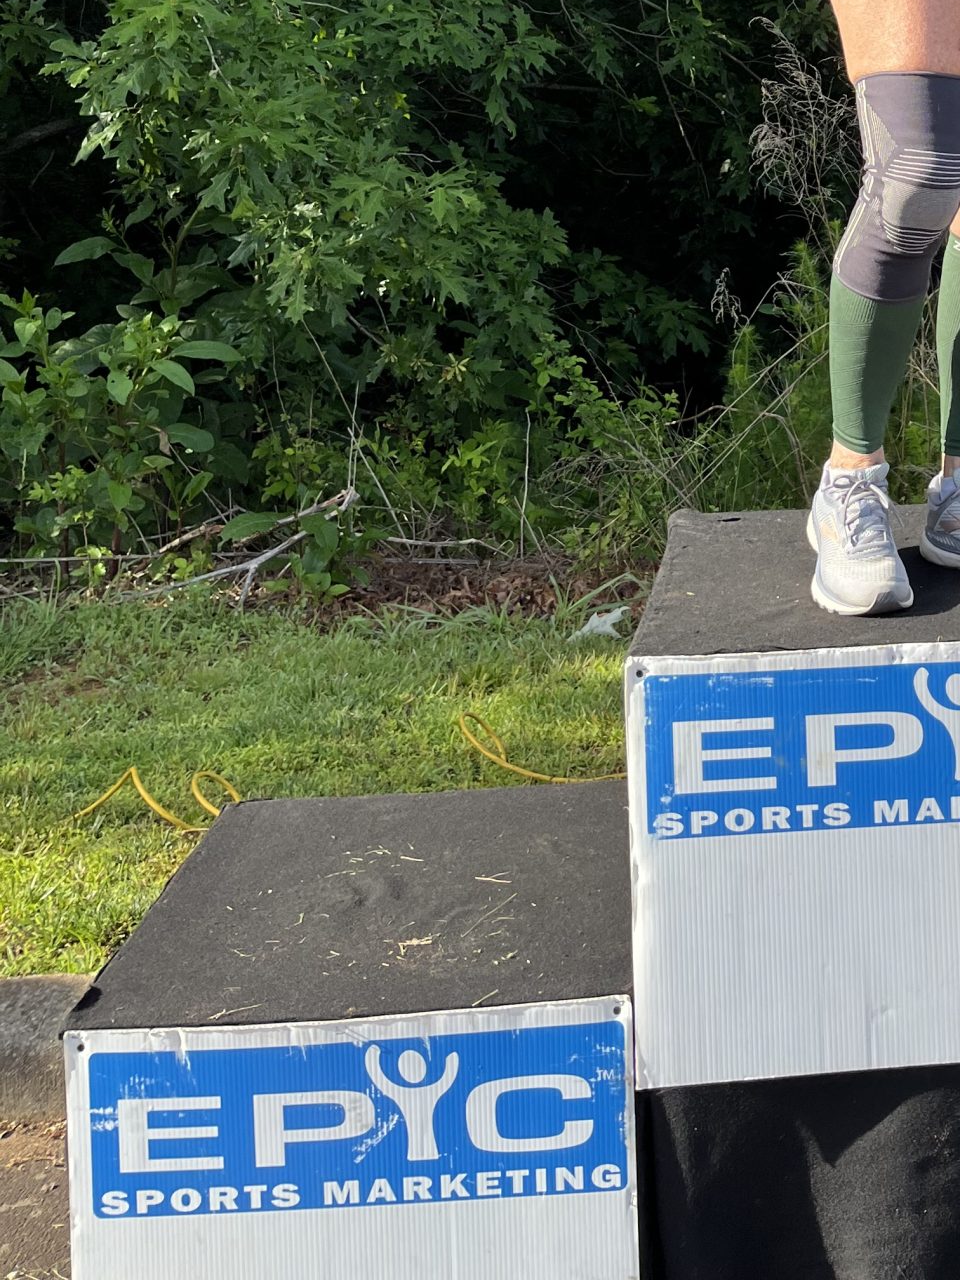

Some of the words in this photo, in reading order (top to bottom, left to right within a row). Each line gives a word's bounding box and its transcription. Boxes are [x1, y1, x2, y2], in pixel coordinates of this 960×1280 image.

[655, 802, 852, 837] SPORTS
[100, 1183, 300, 1216] SPORTS
[323, 1163, 622, 1206] MARKETING
